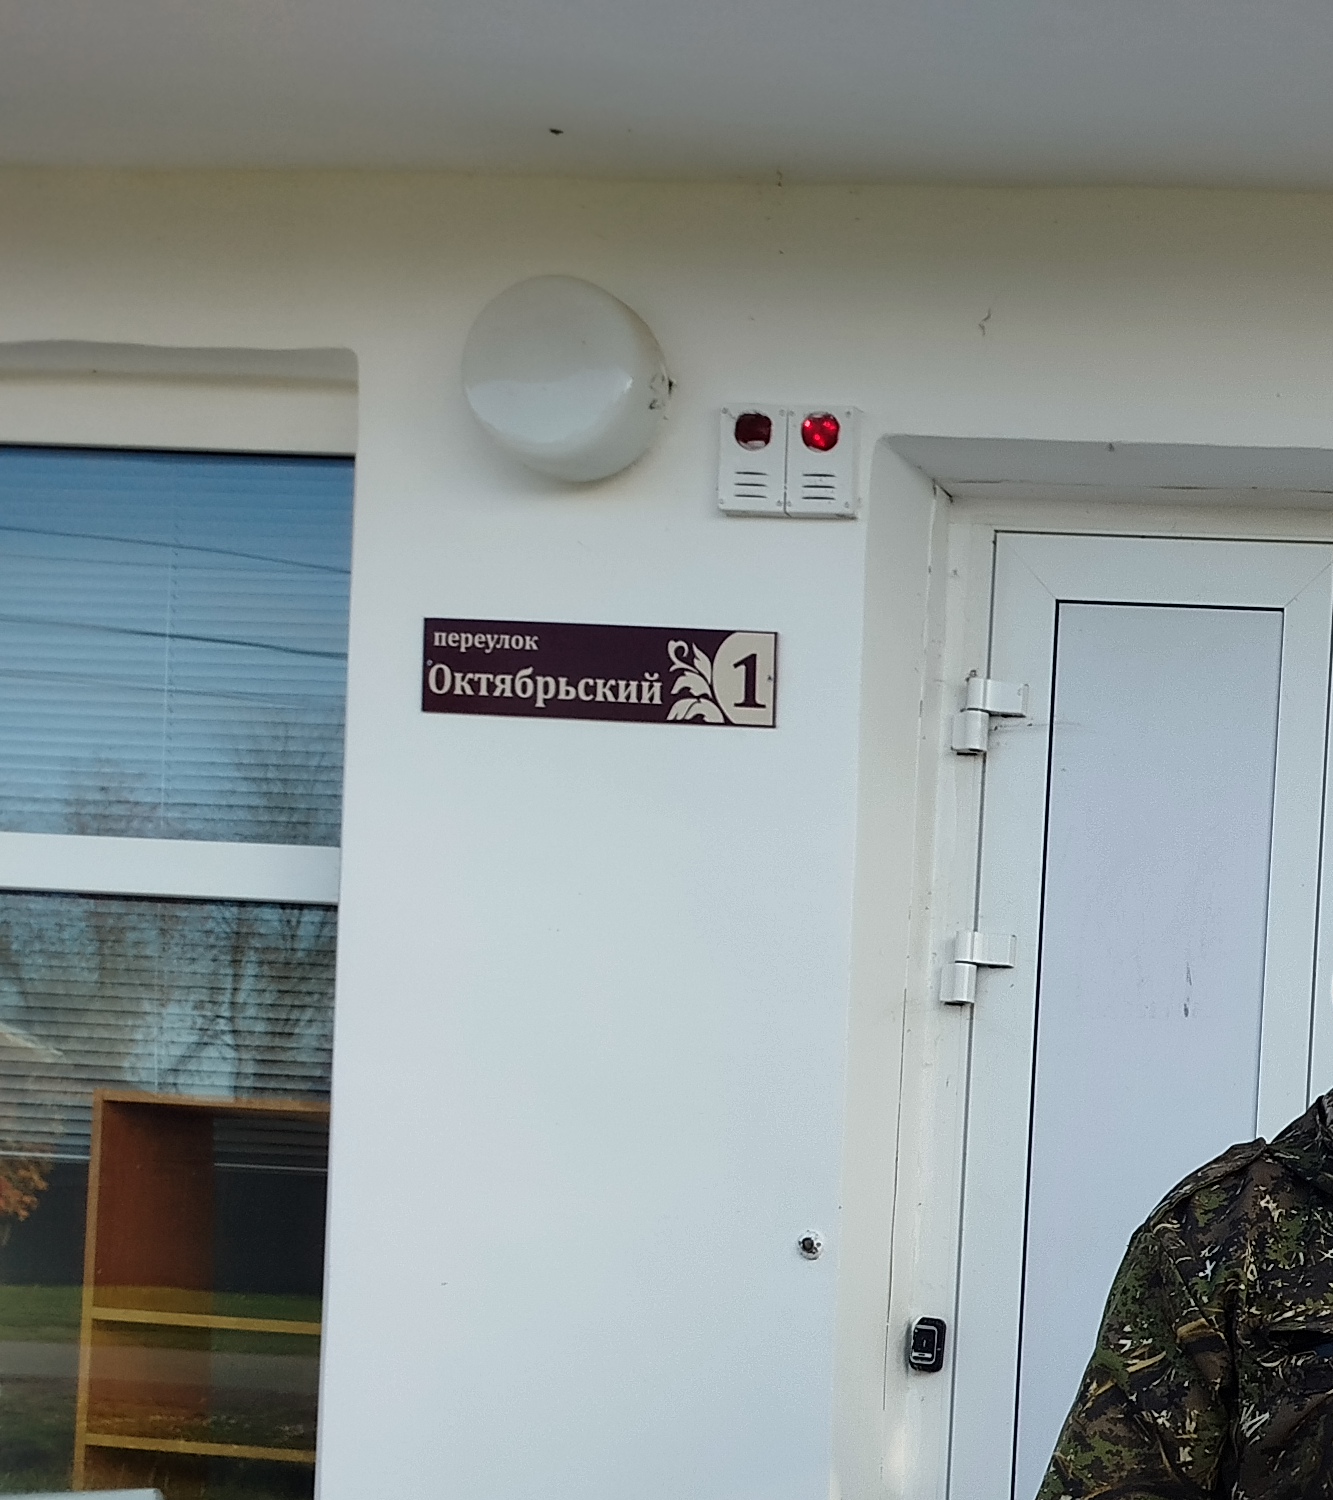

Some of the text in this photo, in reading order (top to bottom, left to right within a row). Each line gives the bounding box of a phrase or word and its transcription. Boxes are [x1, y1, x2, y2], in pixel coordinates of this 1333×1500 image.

[434, 632, 539, 654] переулок
[428, 663, 662, 708] Октябрьский
[732, 653, 767, 709] 1
